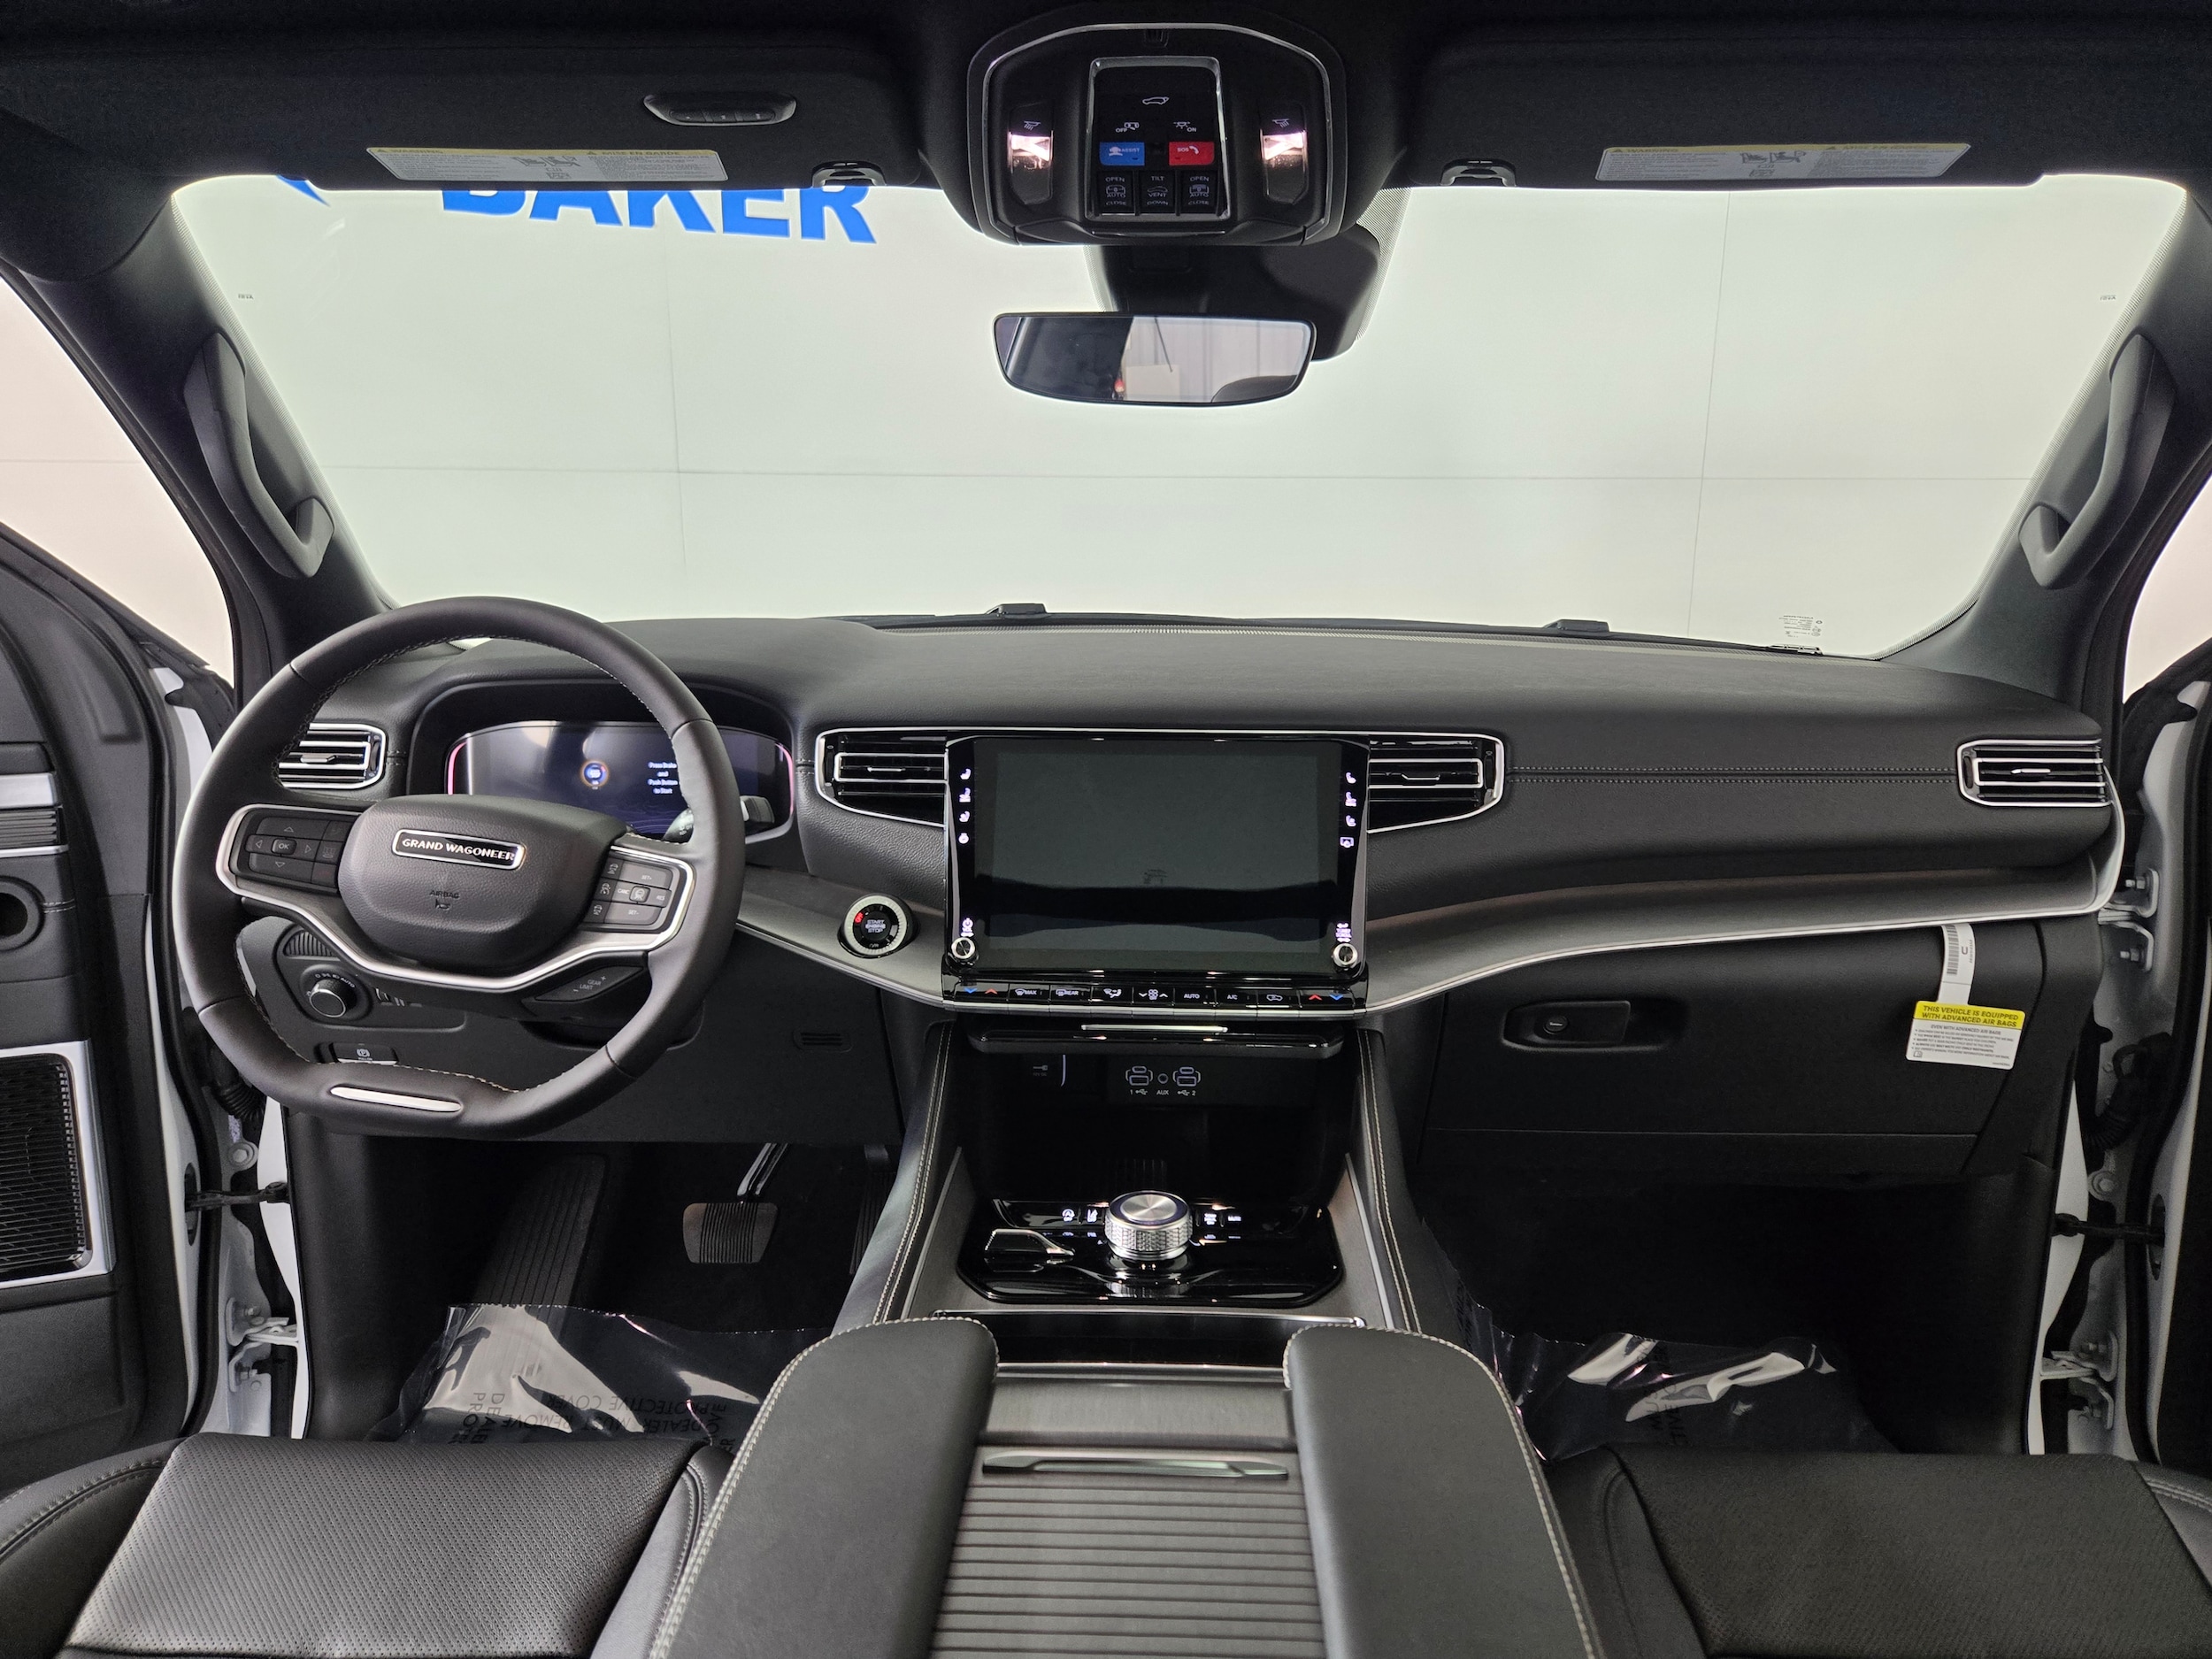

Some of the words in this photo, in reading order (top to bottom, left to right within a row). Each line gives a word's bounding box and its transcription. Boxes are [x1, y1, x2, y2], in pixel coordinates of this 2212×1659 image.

[442, 186, 877, 244] KER
[402, 838, 444, 850] GRAND
[445, 843, 515, 861] WAGONEER
[429, 889, 460, 899] AIRBAG
[340, 977, 356, 988] AUTO
[1941, 1013, 1982, 1024] ADVANCED
[1981, 1011, 2019, 1021] EQUIPPED
[548, 1394, 603, 1411] COVER
[608, 1395, 710, 1415] PROTECTIVE
[470, 1393, 506, 1444] DEALE
[643, 1417, 702, 1434] DEALER
